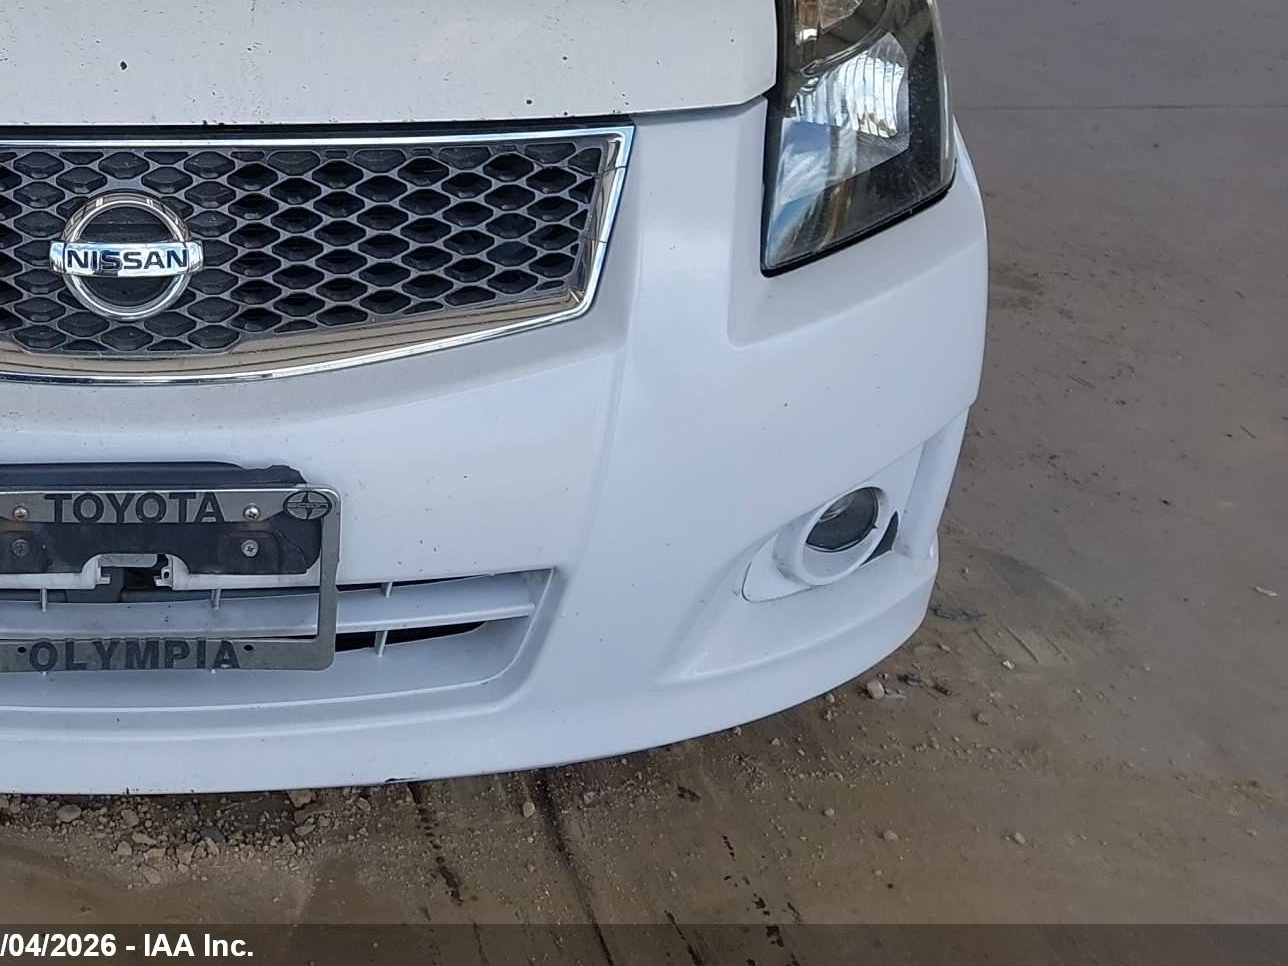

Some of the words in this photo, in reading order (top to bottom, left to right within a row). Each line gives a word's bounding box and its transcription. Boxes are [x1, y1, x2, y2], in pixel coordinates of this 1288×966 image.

[67, 249, 188, 270] NISSAN
[45, 492, 228, 523] TOYOTA
[29, 640, 241, 671] OLYMPIA
